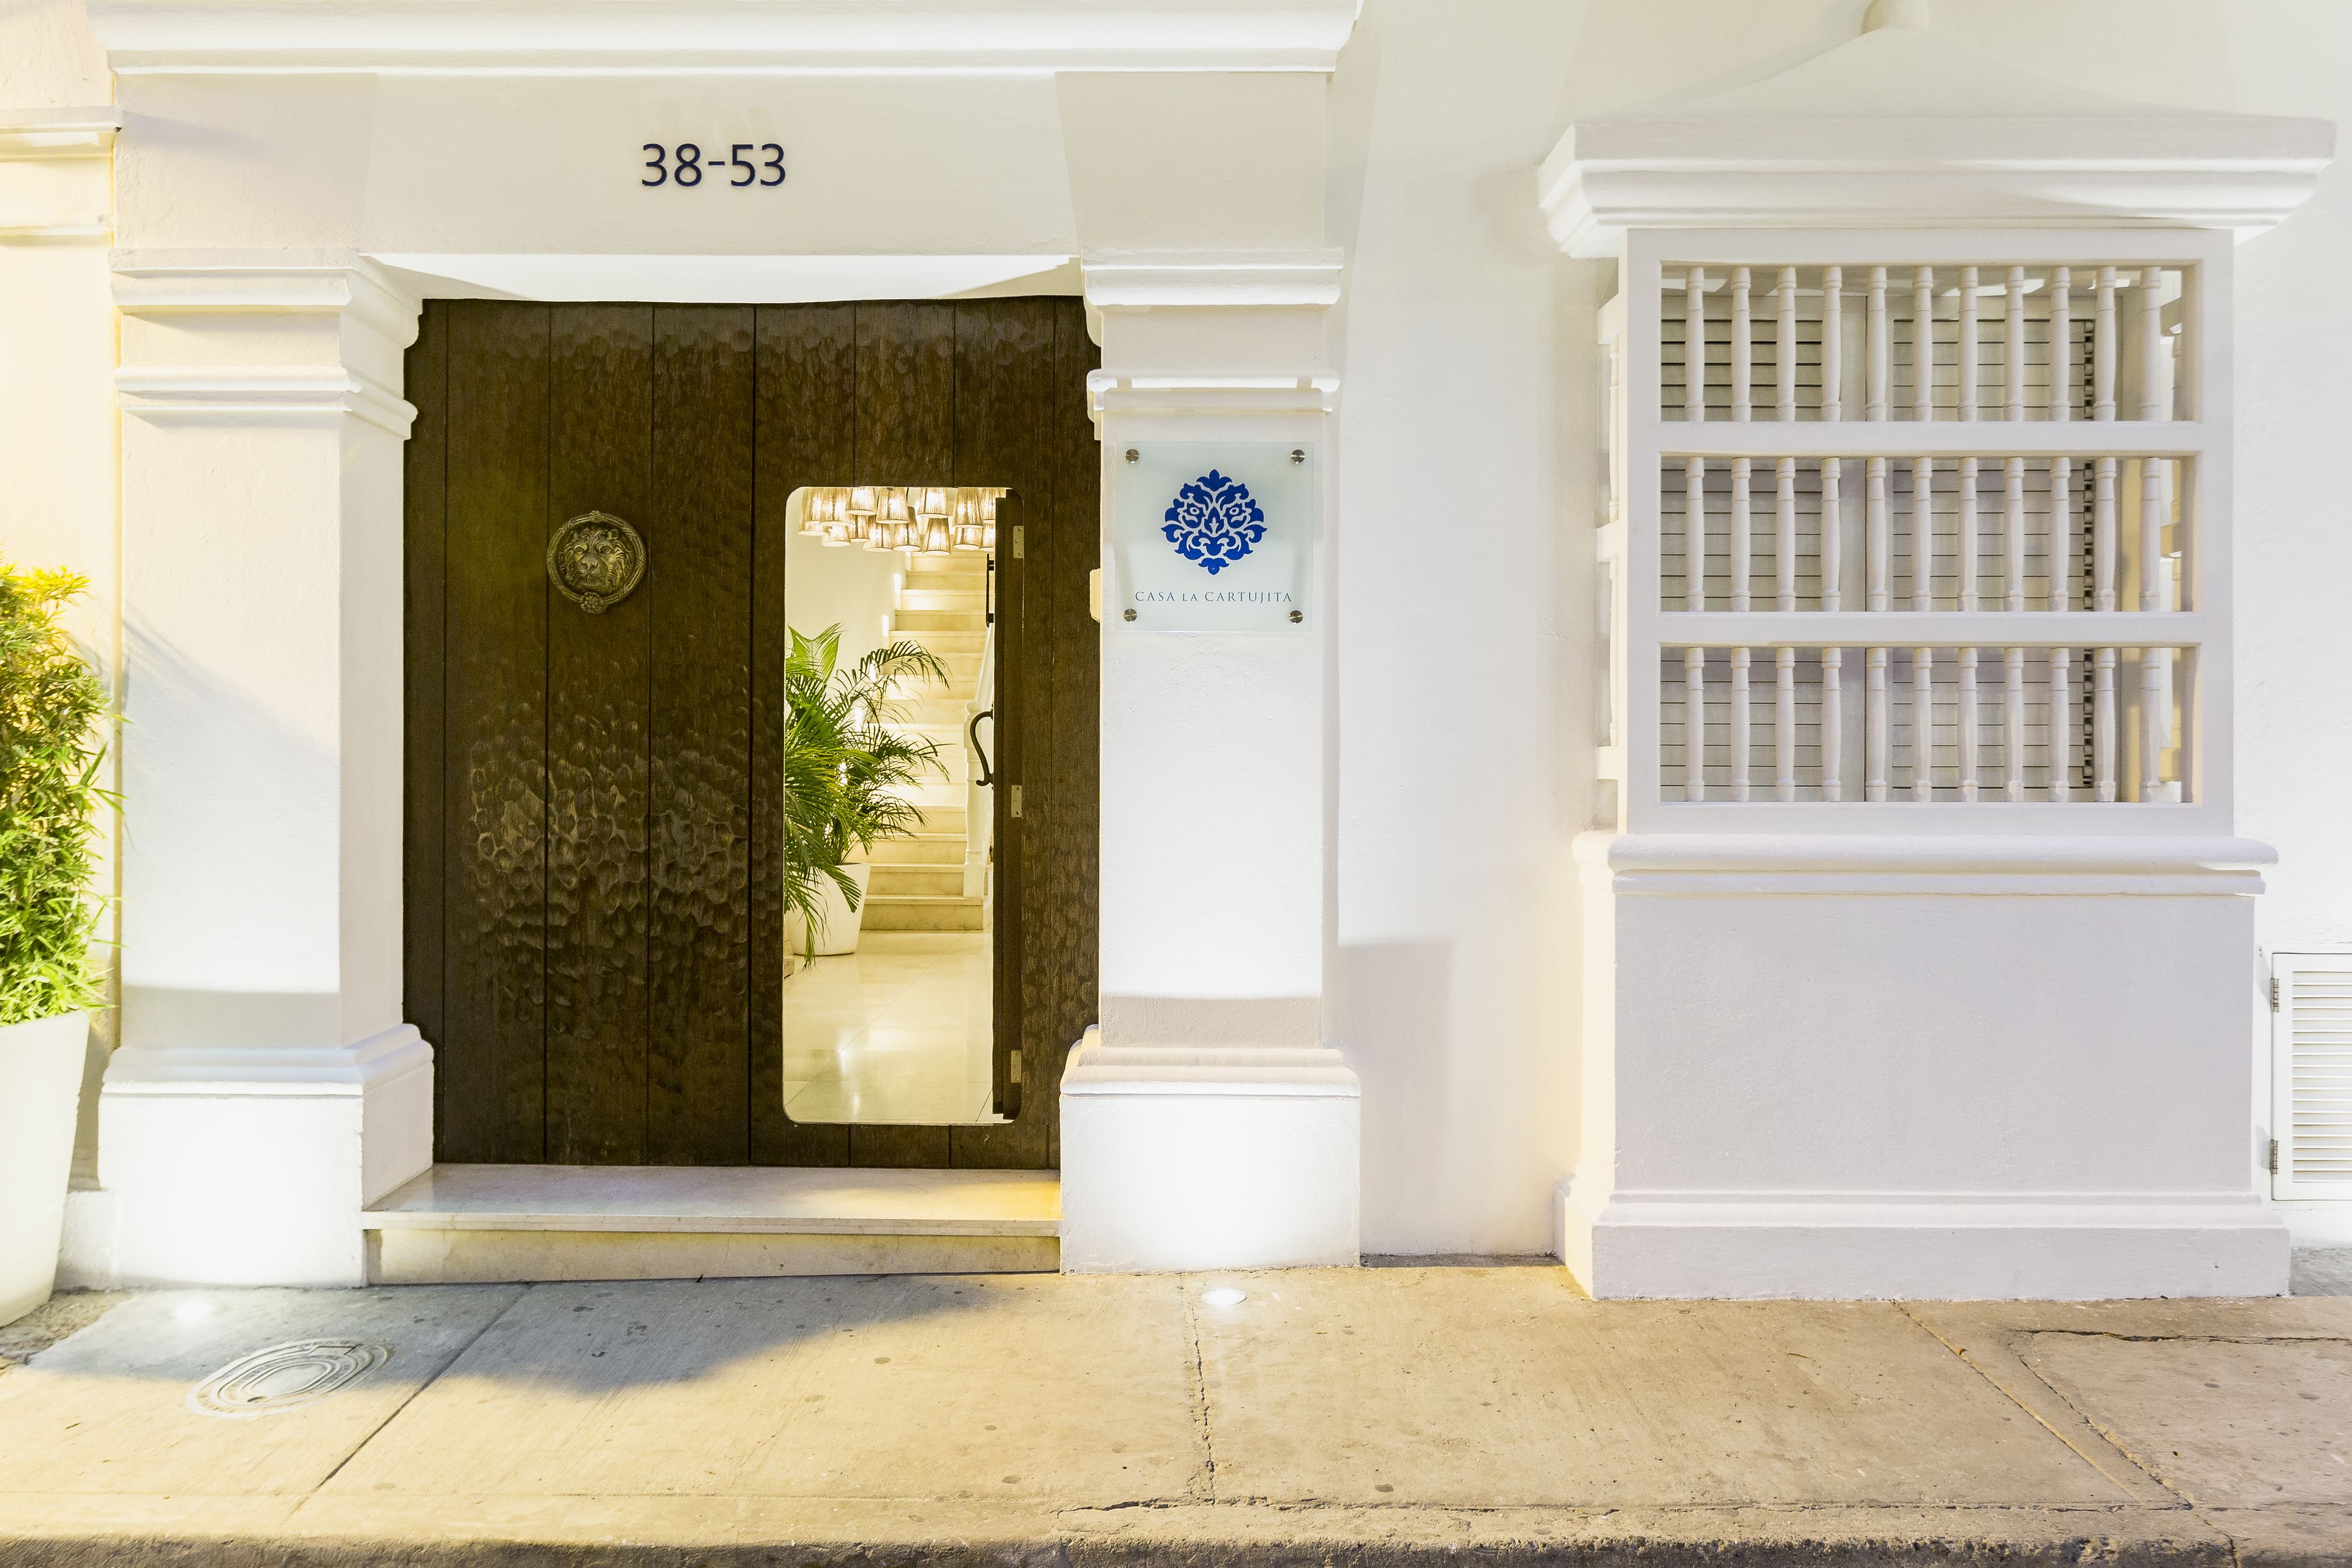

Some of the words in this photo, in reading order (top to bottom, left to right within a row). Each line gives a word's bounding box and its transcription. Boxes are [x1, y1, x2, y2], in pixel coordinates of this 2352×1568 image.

[641, 143, 786, 187] 38-53
[1135, 591, 1174, 602] CASA
[1182, 593, 1197, 601] LA
[1205, 592, 1292, 604] CARTUJITA
